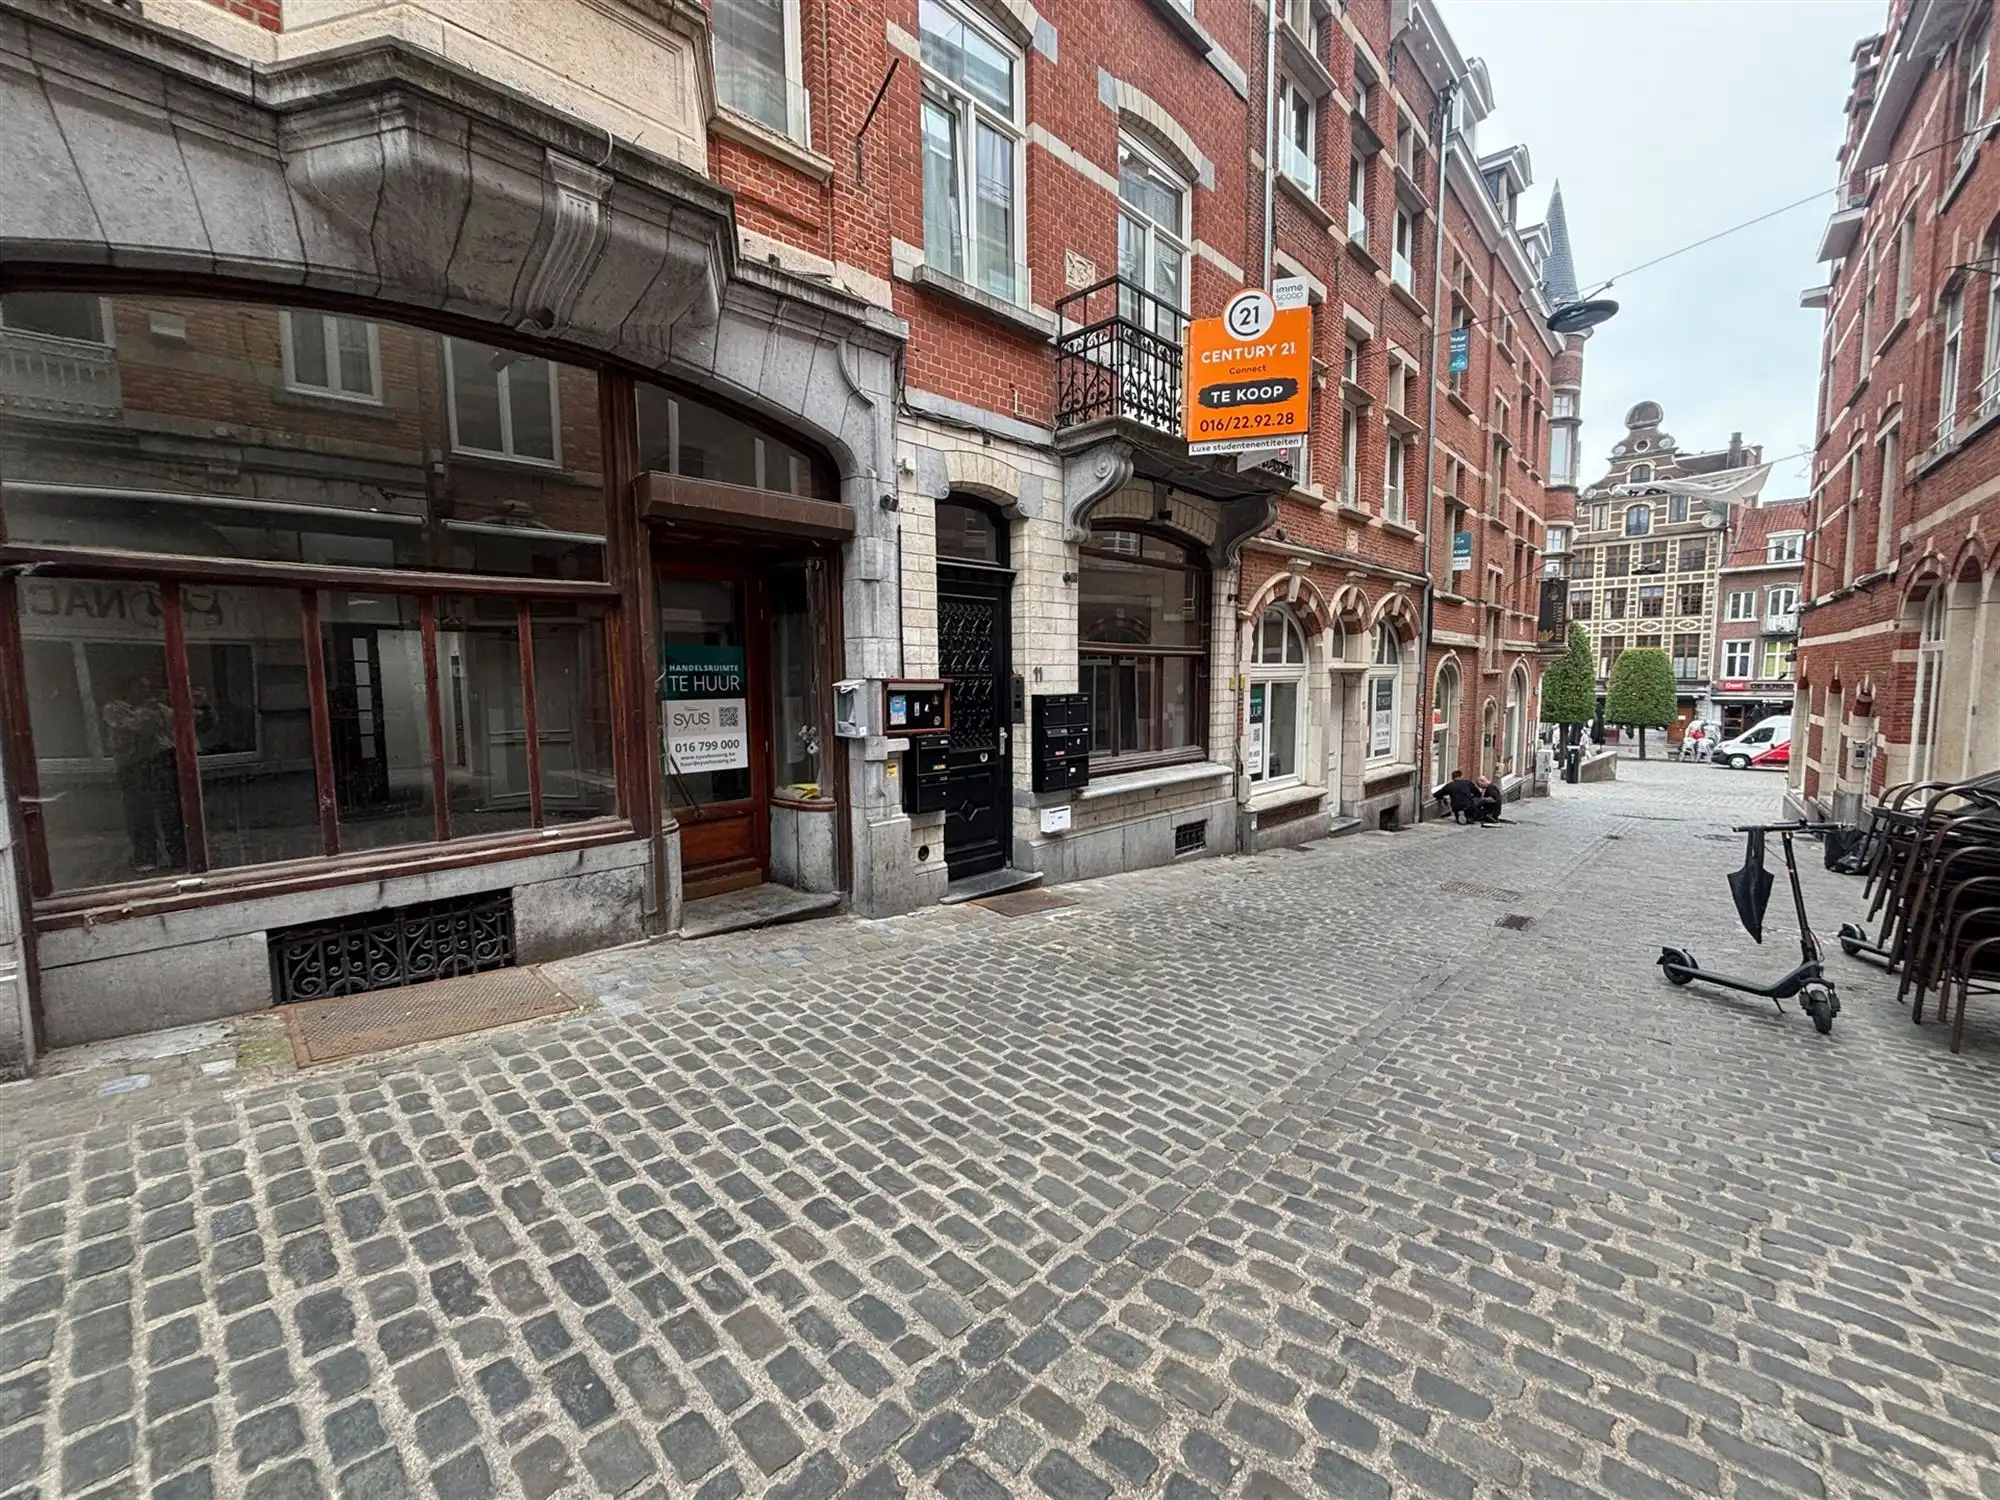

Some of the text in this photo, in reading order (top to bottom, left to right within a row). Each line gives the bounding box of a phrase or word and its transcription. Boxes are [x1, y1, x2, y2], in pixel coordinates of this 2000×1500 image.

[1201, 342, 1297, 364] CENTURY 21
[1229, 364, 1268, 375] Connect
[1211, 385, 1284, 404] TE KOOP
[1200, 412, 1295, 432] 016/22.92.28
[1191, 438, 1299, 453] Luxe studentenentiteiten
[669, 664, 739, 672] HANDELSRUIMTE
[1033, 666, 1043, 682] 11
[668, 675, 740, 692] TE HUUR
[673, 711, 711, 729] syus
[675, 739, 740, 753] 016 799 000
